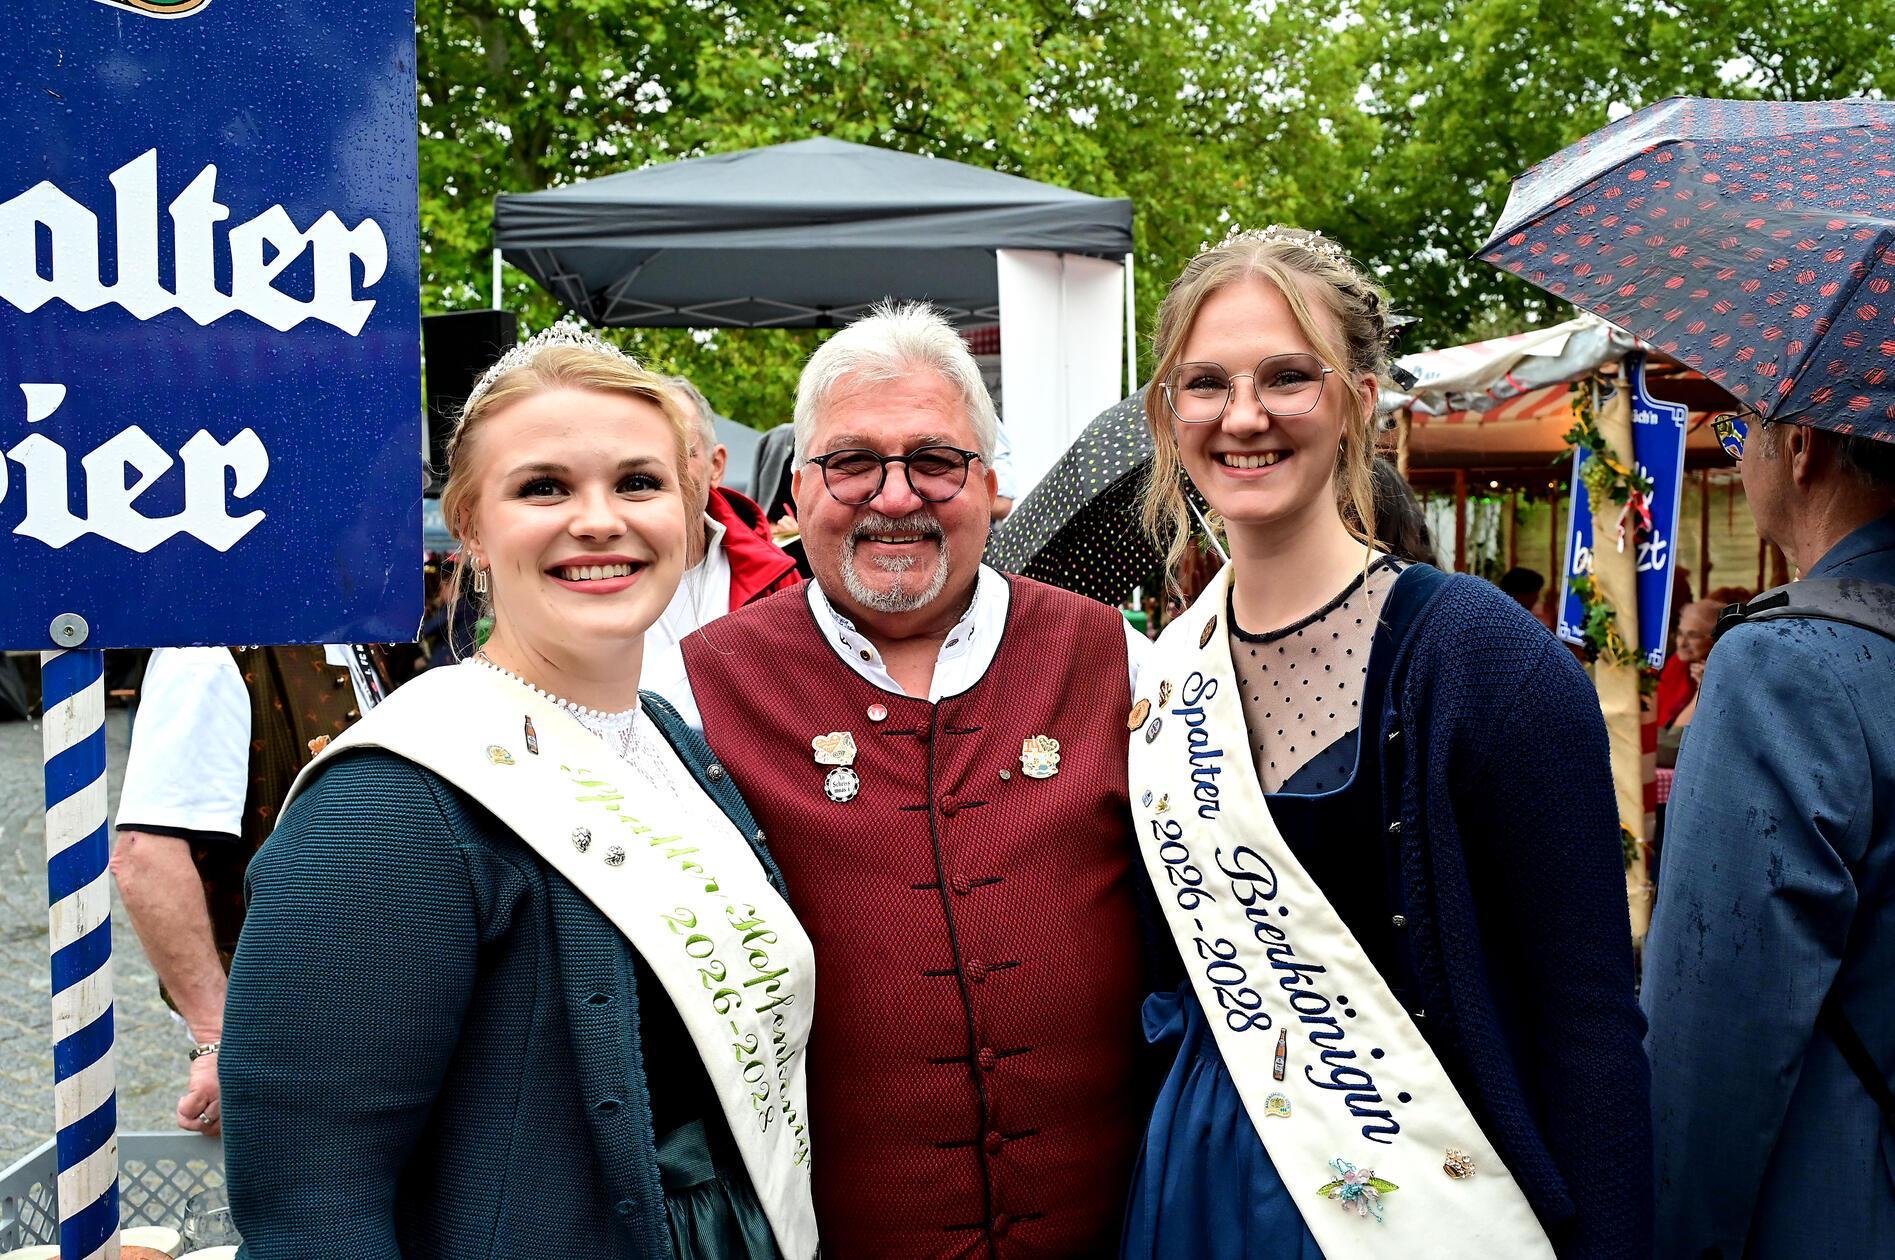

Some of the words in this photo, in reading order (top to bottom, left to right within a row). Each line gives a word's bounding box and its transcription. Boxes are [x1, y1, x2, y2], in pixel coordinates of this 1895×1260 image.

[0, 384, 270, 553] ier
[1171, 671, 1225, 820] Spalter
[1215, 846, 1413, 1145] Bierkönigin
